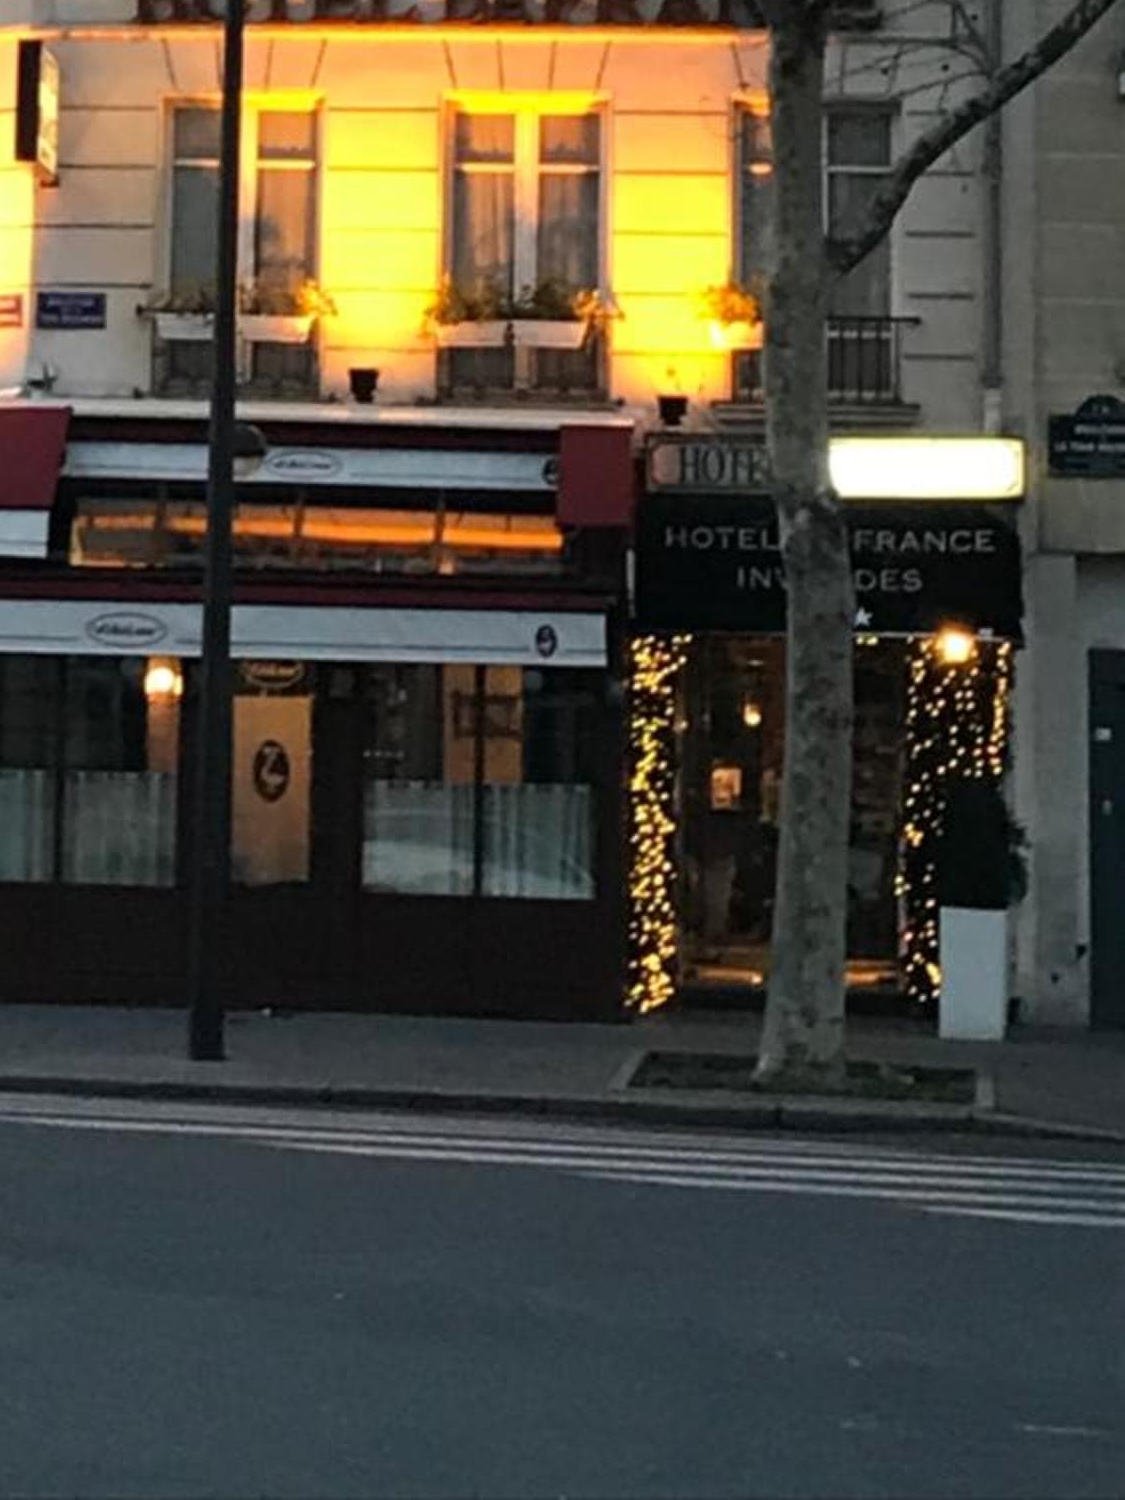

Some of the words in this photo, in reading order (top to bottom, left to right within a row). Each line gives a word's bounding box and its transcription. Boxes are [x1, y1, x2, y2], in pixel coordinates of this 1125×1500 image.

[679, 447, 768, 485] HOTE
[664, 525, 780, 550] HOTEL
[853, 528, 997, 553] FRANCE
